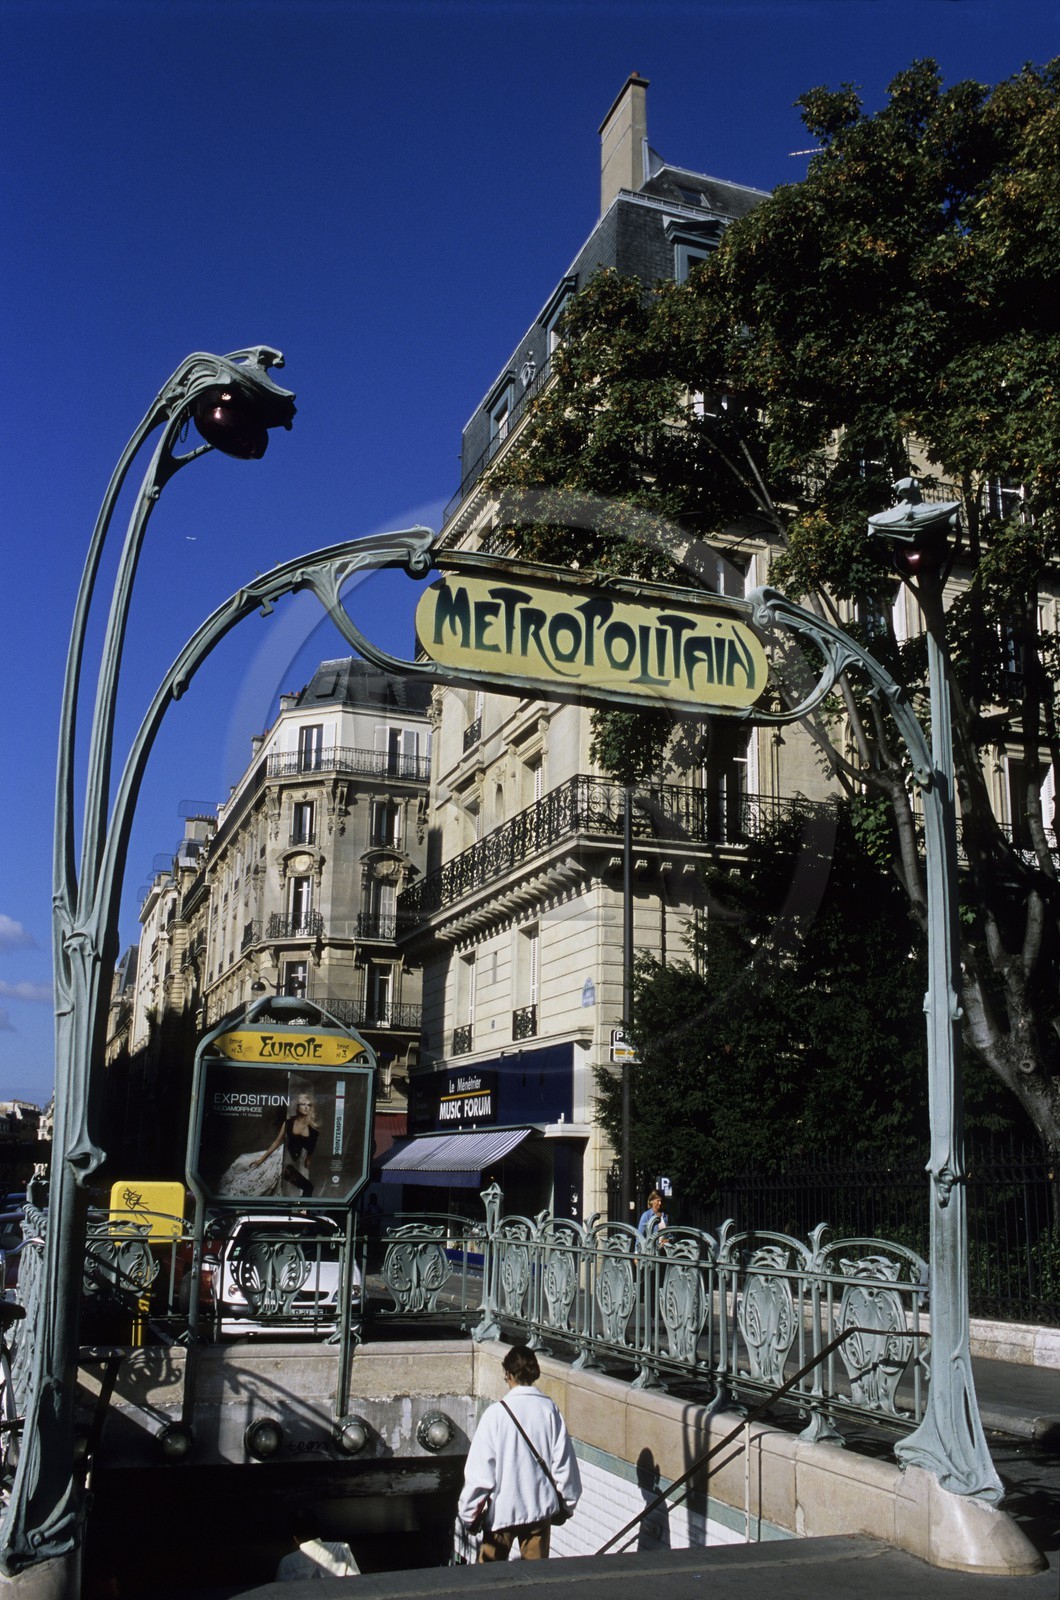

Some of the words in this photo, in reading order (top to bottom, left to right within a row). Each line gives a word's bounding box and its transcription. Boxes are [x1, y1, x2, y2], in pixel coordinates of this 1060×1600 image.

[433, 584, 756, 691] METROPOLITAIN
[616, 1031, 624, 1041] P
[259, 1036, 322, 1060] EUROPE
[449, 1080, 455, 1094] Le
[213, 1093, 290, 1107] EXPOSITION
[439, 1100, 461, 1121] MUSIC
[464, 1096, 491, 1118] FORUM
[334, 1116, 343, 1156] PRINTEMPS
[661, 1177, 670, 1190] P
